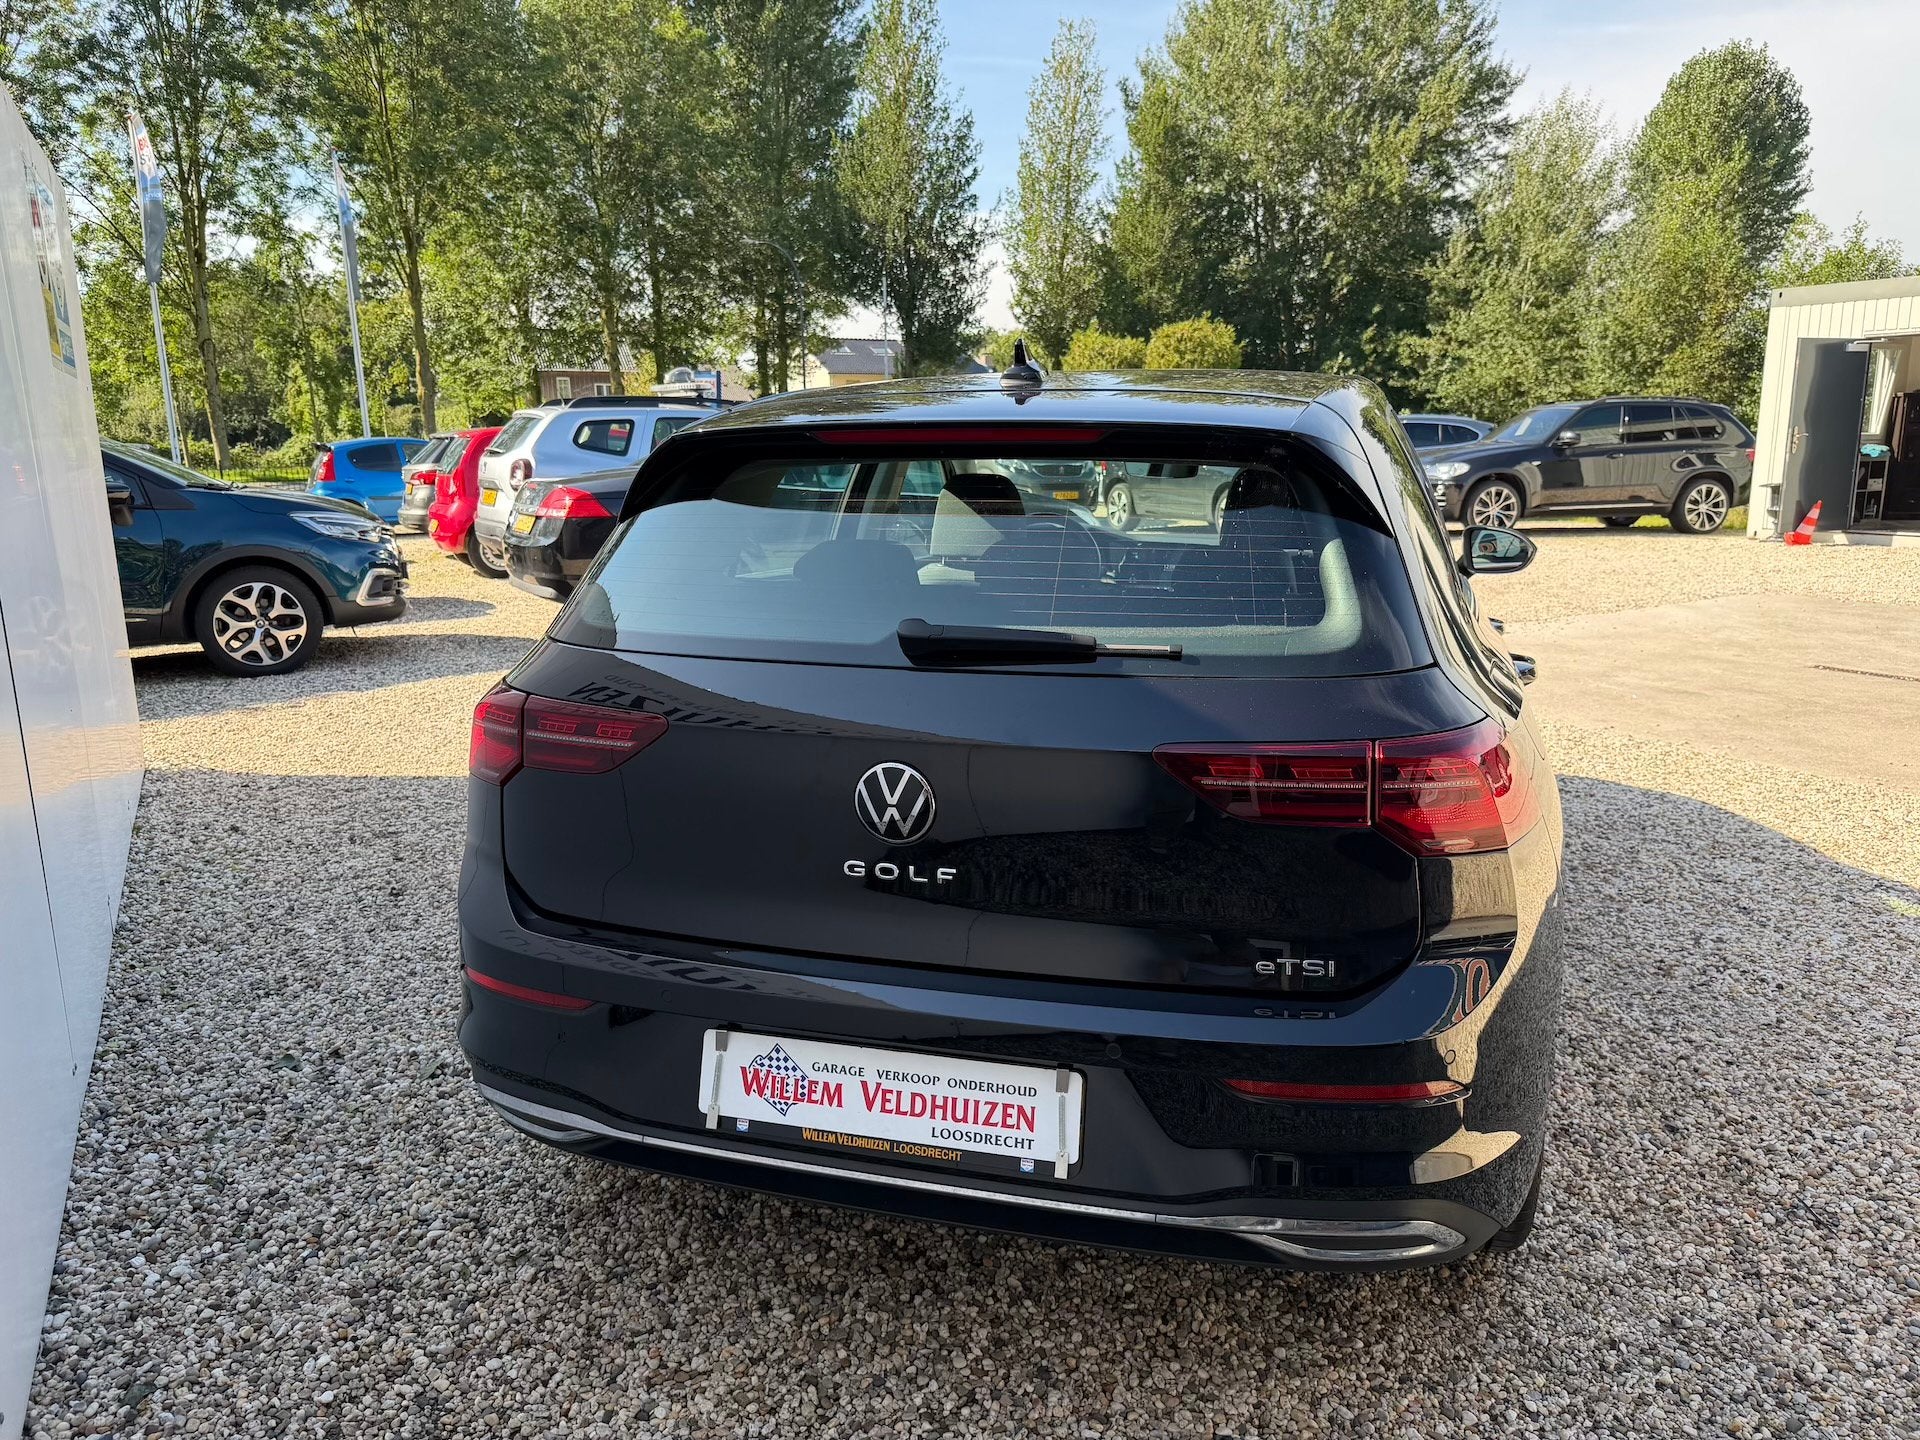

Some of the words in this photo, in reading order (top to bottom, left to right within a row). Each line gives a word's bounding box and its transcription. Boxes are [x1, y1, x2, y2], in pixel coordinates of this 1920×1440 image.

[843, 860, 957, 884] GOLF
[1255, 958, 1335, 978] eTSI
[811, 1061, 865, 1078] GARAGE
[876, 1068, 941, 1087] VERKOOP
[947, 1077, 1038, 1098] ONDERHOUD
[739, 1065, 844, 1109] WILLEM
[860, 1079, 1037, 1134] VELDHUIZEN
[801, 1127, 836, 1145] WILLEM
[836, 1132, 891, 1152] VELDHUIZEN
[893, 1142, 963, 1163] LOOSDRECHT
[930, 1126, 1035, 1151] LOOSDRECHT
